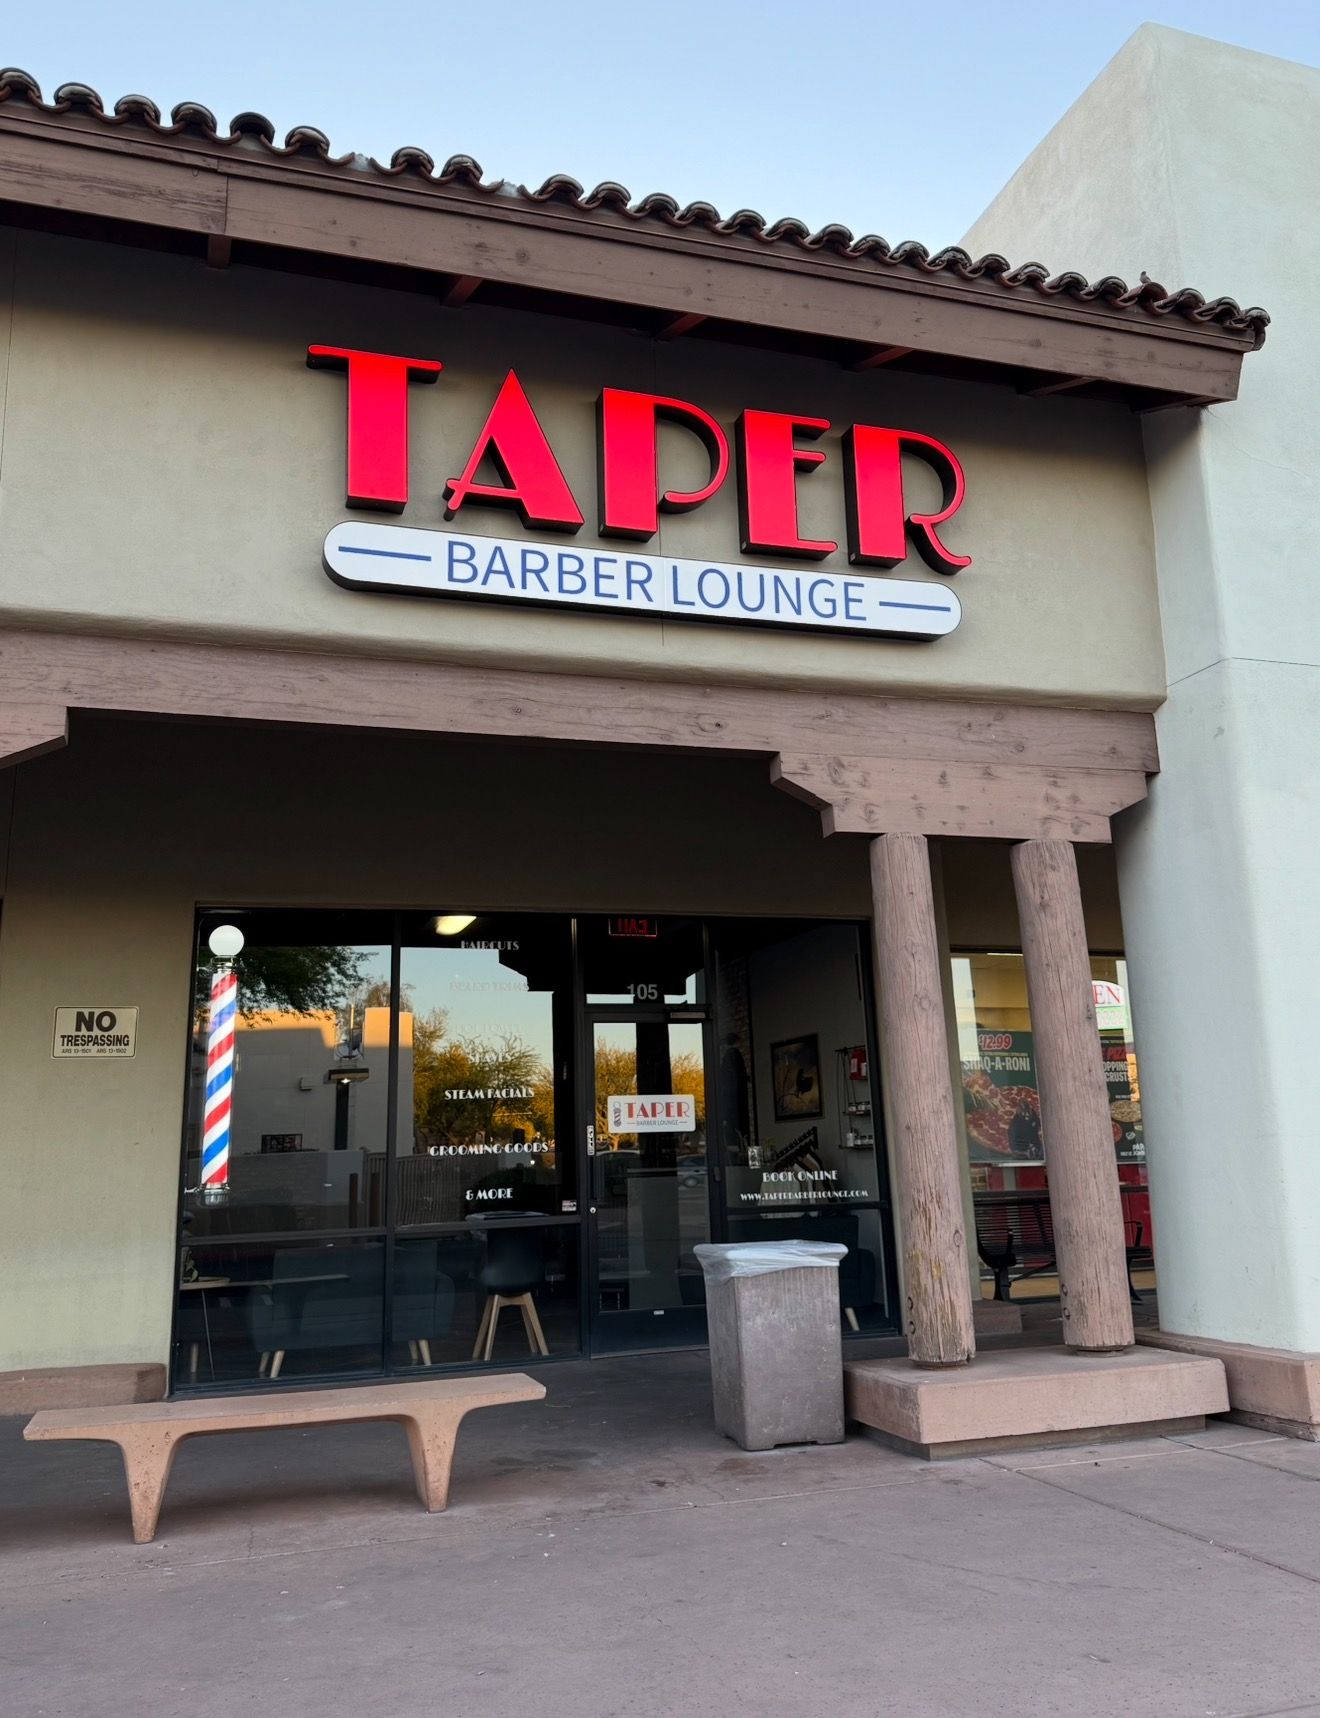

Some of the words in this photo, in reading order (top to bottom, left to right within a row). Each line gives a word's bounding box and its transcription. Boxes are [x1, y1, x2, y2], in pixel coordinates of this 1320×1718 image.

[308, 344, 972, 573] TAPER
[446, 540, 654, 603] BARBER
[672, 565, 868, 622] LOUNGE
[460, 940, 520, 951] HAIRCUTS
[627, 983, 658, 1000] 105
[1092, 984, 1121, 1004] EN
[75, 1010, 117, 1033] NO
[60, 1034, 130, 1047] TRESPASSING
[963, 1056, 1031, 1073] SHAQ-A-RONI
[444, 1088, 485, 1100] STEAM
[487, 1087, 535, 1099] FACIALS
[624, 1101, 690, 1118] TAPER
[430, 1143, 502, 1157] GROOMING
[504, 1141, 549, 1154] GOODS
[762, 1171, 796, 1182] BOOK
[797, 1169, 839, 1181] ONLINE
[465, 1189, 475, 1201] &
[476, 1187, 514, 1200] MORE
